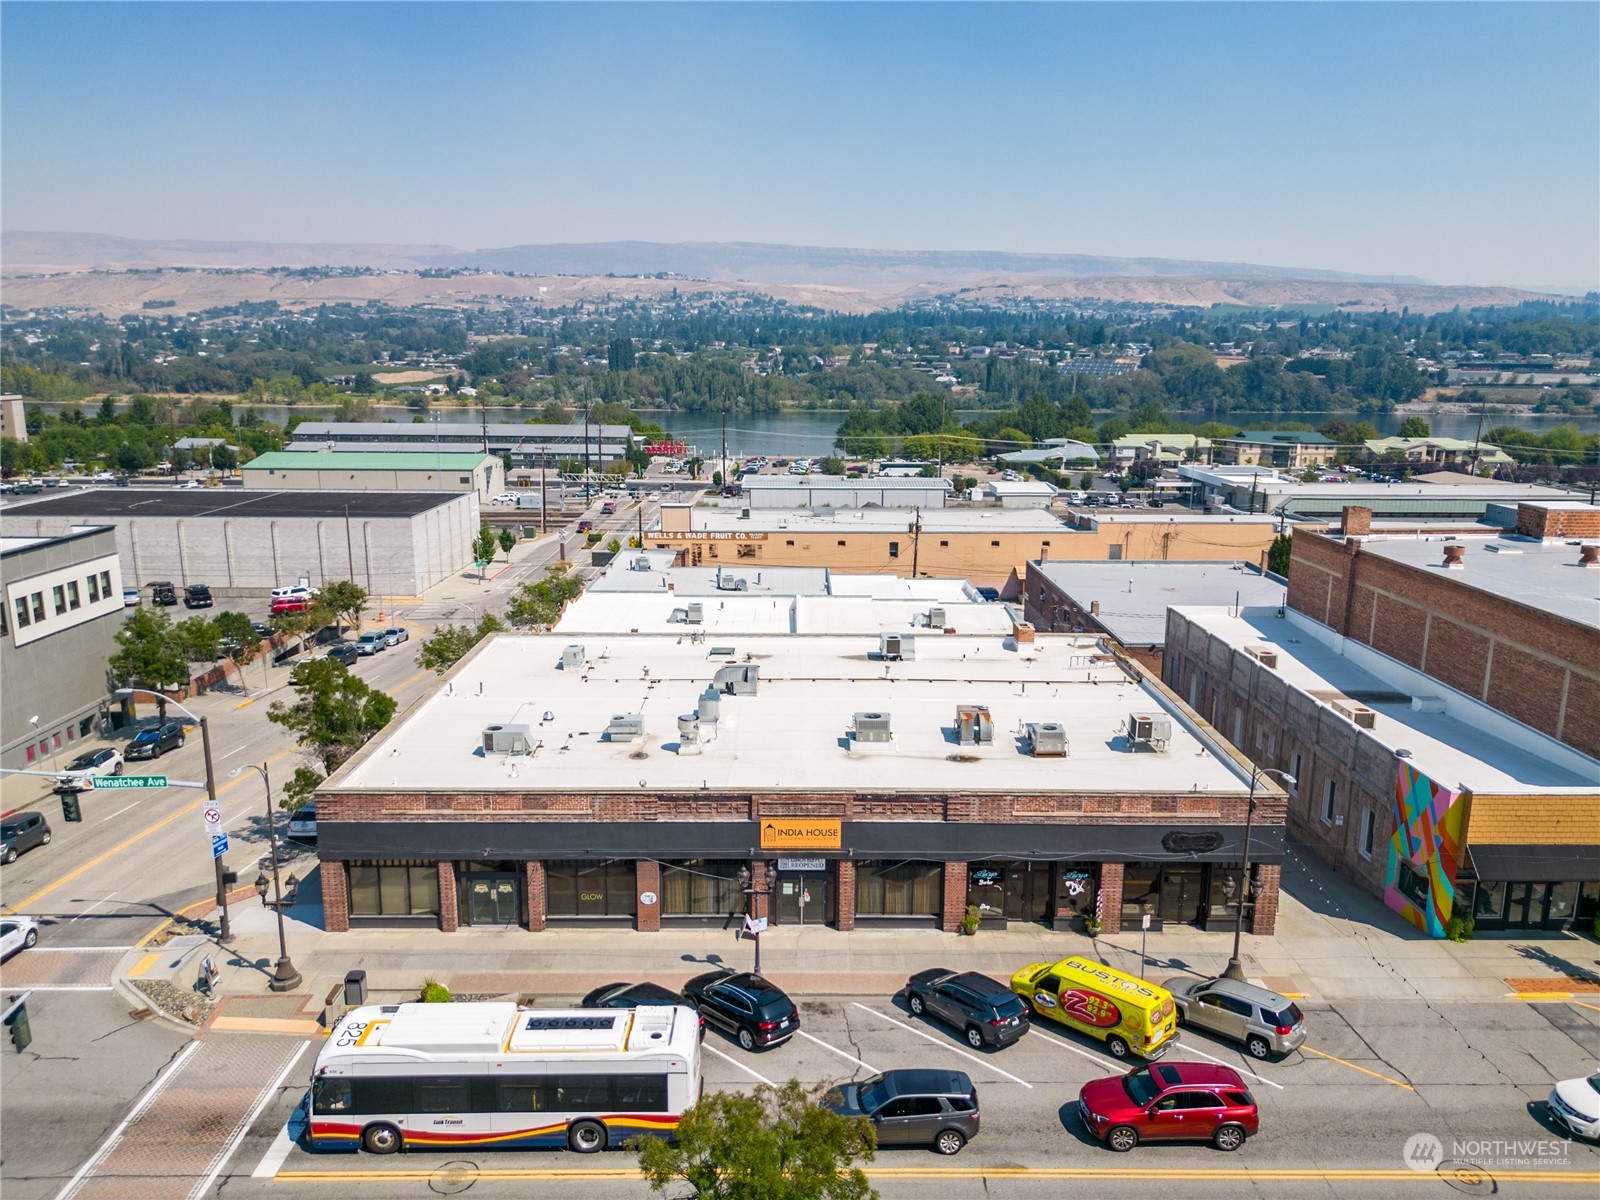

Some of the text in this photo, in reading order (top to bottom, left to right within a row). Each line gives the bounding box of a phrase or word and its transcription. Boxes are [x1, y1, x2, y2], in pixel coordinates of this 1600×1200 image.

[646, 446, 689, 454] MARKET
[735, 532, 748, 540] CO.
[94, 777, 165, 788] Wenatchee Ave
[777, 828, 838, 837] INDIA HOUSE
[580, 893, 604, 901] GLOW
[1066, 960, 1154, 997] BUSTOS
[336, 1022, 367, 1047] 825
